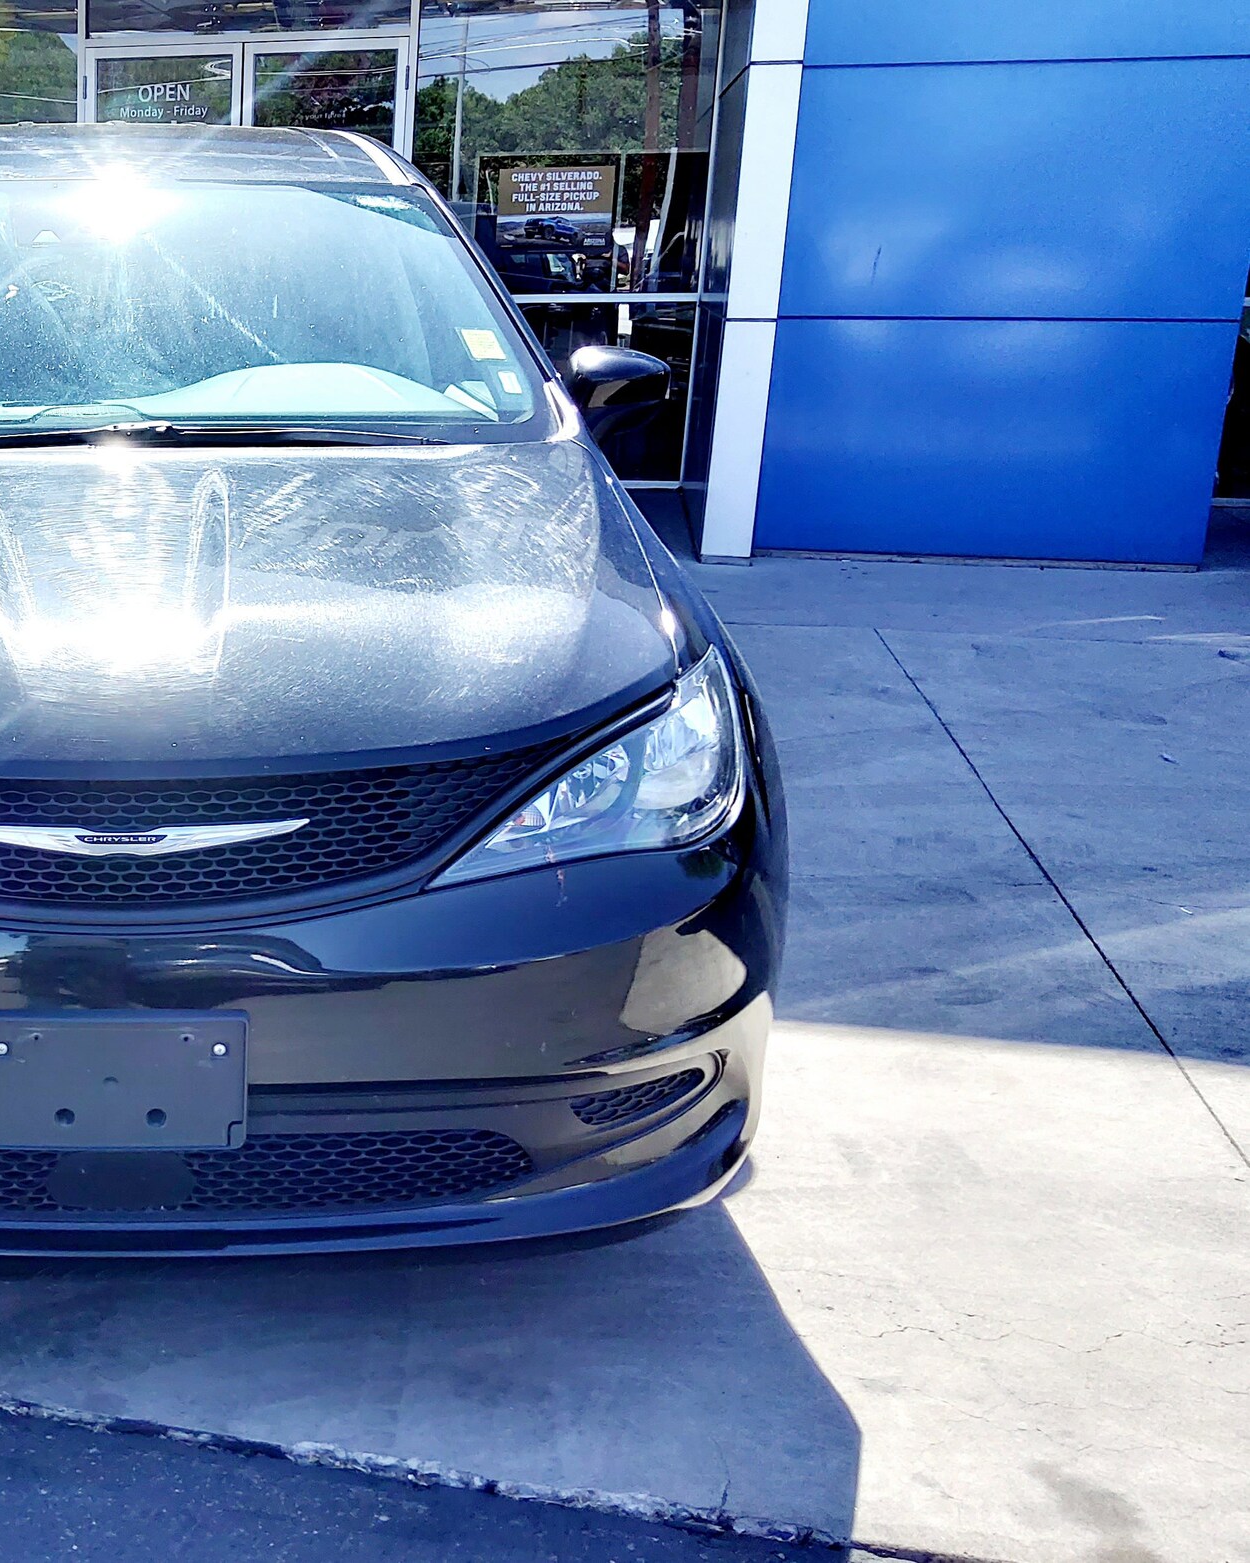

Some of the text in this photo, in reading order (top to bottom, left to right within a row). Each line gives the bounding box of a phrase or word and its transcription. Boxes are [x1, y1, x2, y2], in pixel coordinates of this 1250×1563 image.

[138, 84, 190, 102] OPEN
[119, 106, 164, 119] Monday
[173, 104, 208, 118] Friday
[511, 171, 603, 182] CHEVY SILVERADO.
[519, 181, 593, 192] THE #1 SELLING
[512, 191, 600, 202] FULL-SIZE PICKUP
[526, 202, 584, 212] IN ARIZONA.
